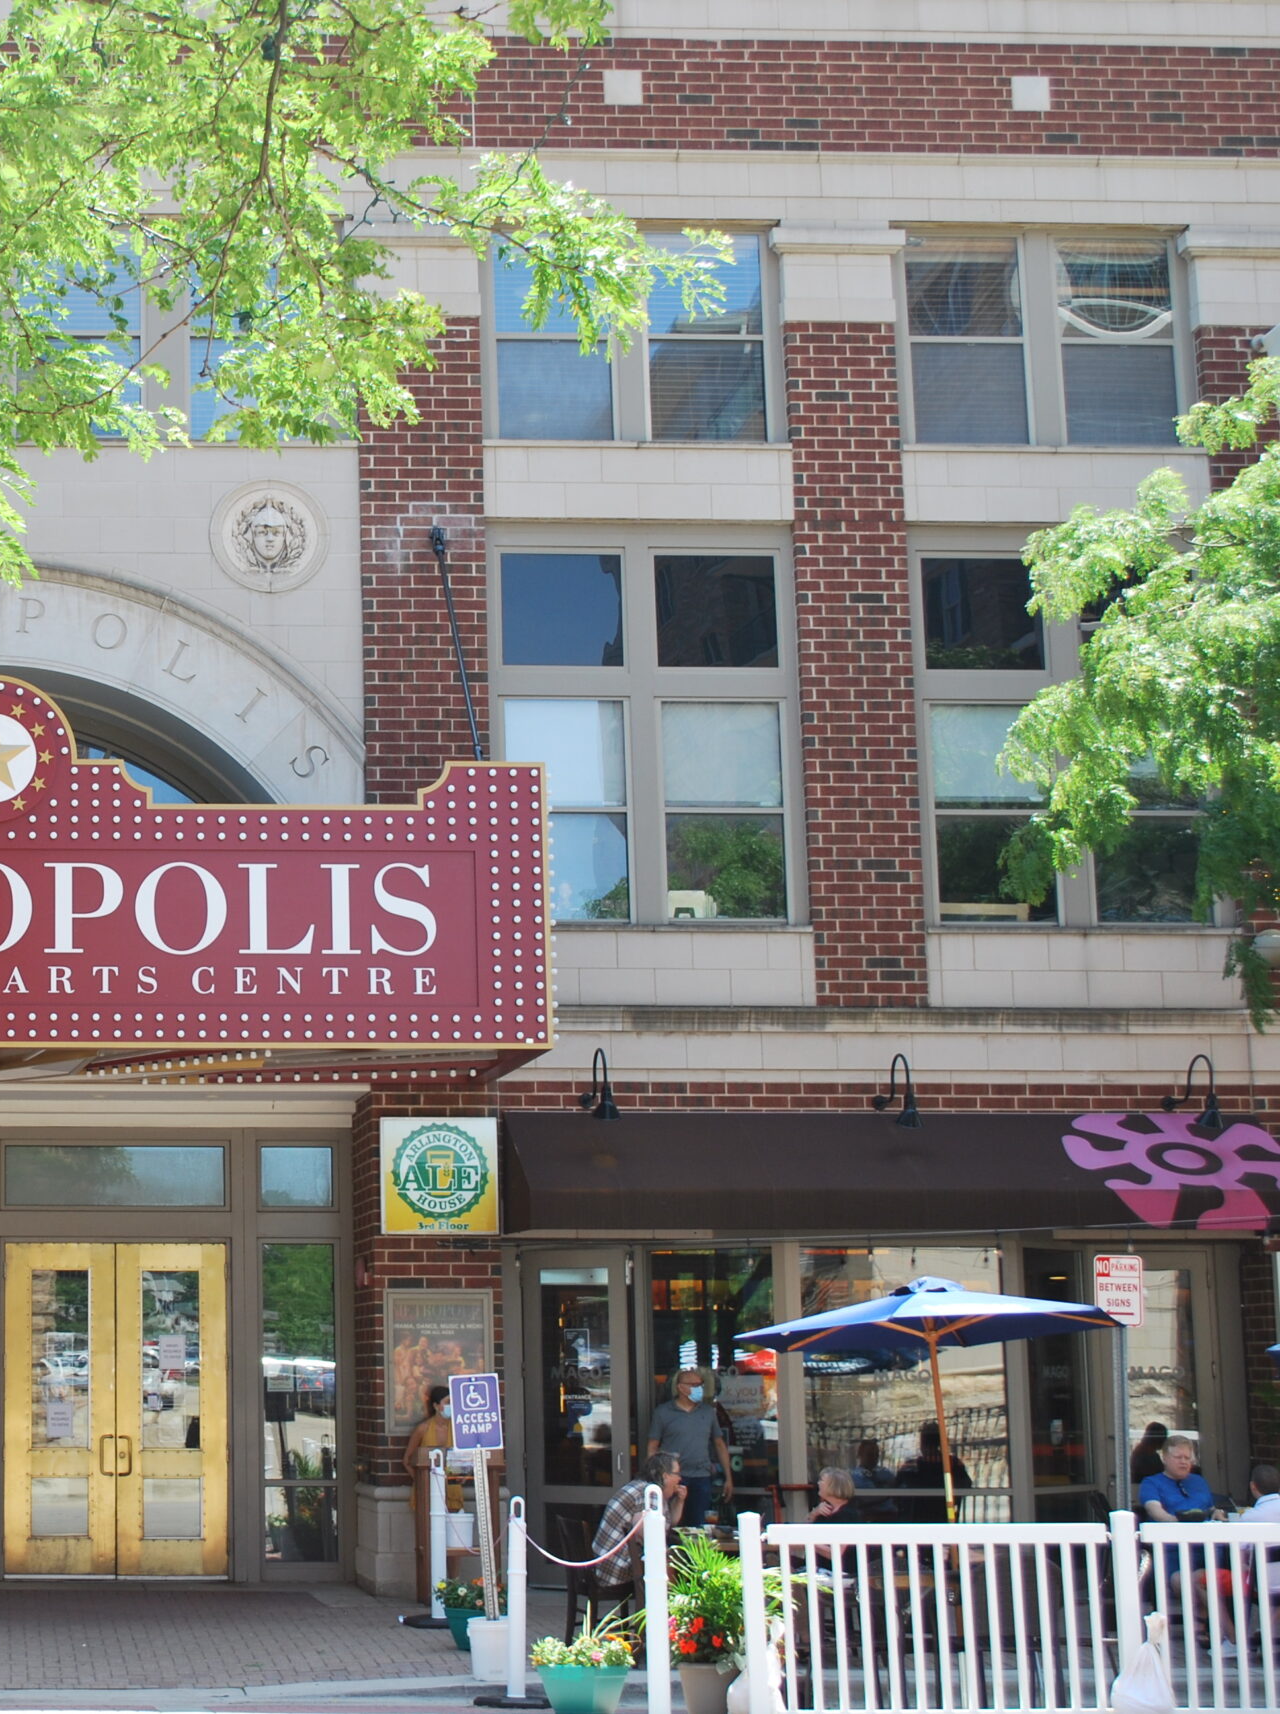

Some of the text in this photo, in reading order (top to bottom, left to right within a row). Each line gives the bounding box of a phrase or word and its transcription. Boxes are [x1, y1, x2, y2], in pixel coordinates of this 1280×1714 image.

[2, 965, 158, 995] ARTS
[192, 966, 438, 996] CENTRE
[406, 1133, 475, 1162] ARLINGTON
[397, 1164, 479, 1192] ALE
[416, 1194, 466, 1210] HOUSE
[418, 1222, 469, 1230] 3rd Floor
[1096, 1260, 1138, 1274] NO PARKING
[1099, 1283, 1138, 1292] BETWEEN
[1106, 1298, 1131, 1307] SIGNS
[551, 1366, 602, 1379] MAGO
[873, 1368, 931, 1382] MAGO
[456, 1411, 498, 1424] ACCESS
[462, 1423, 492, 1434] RAMP
